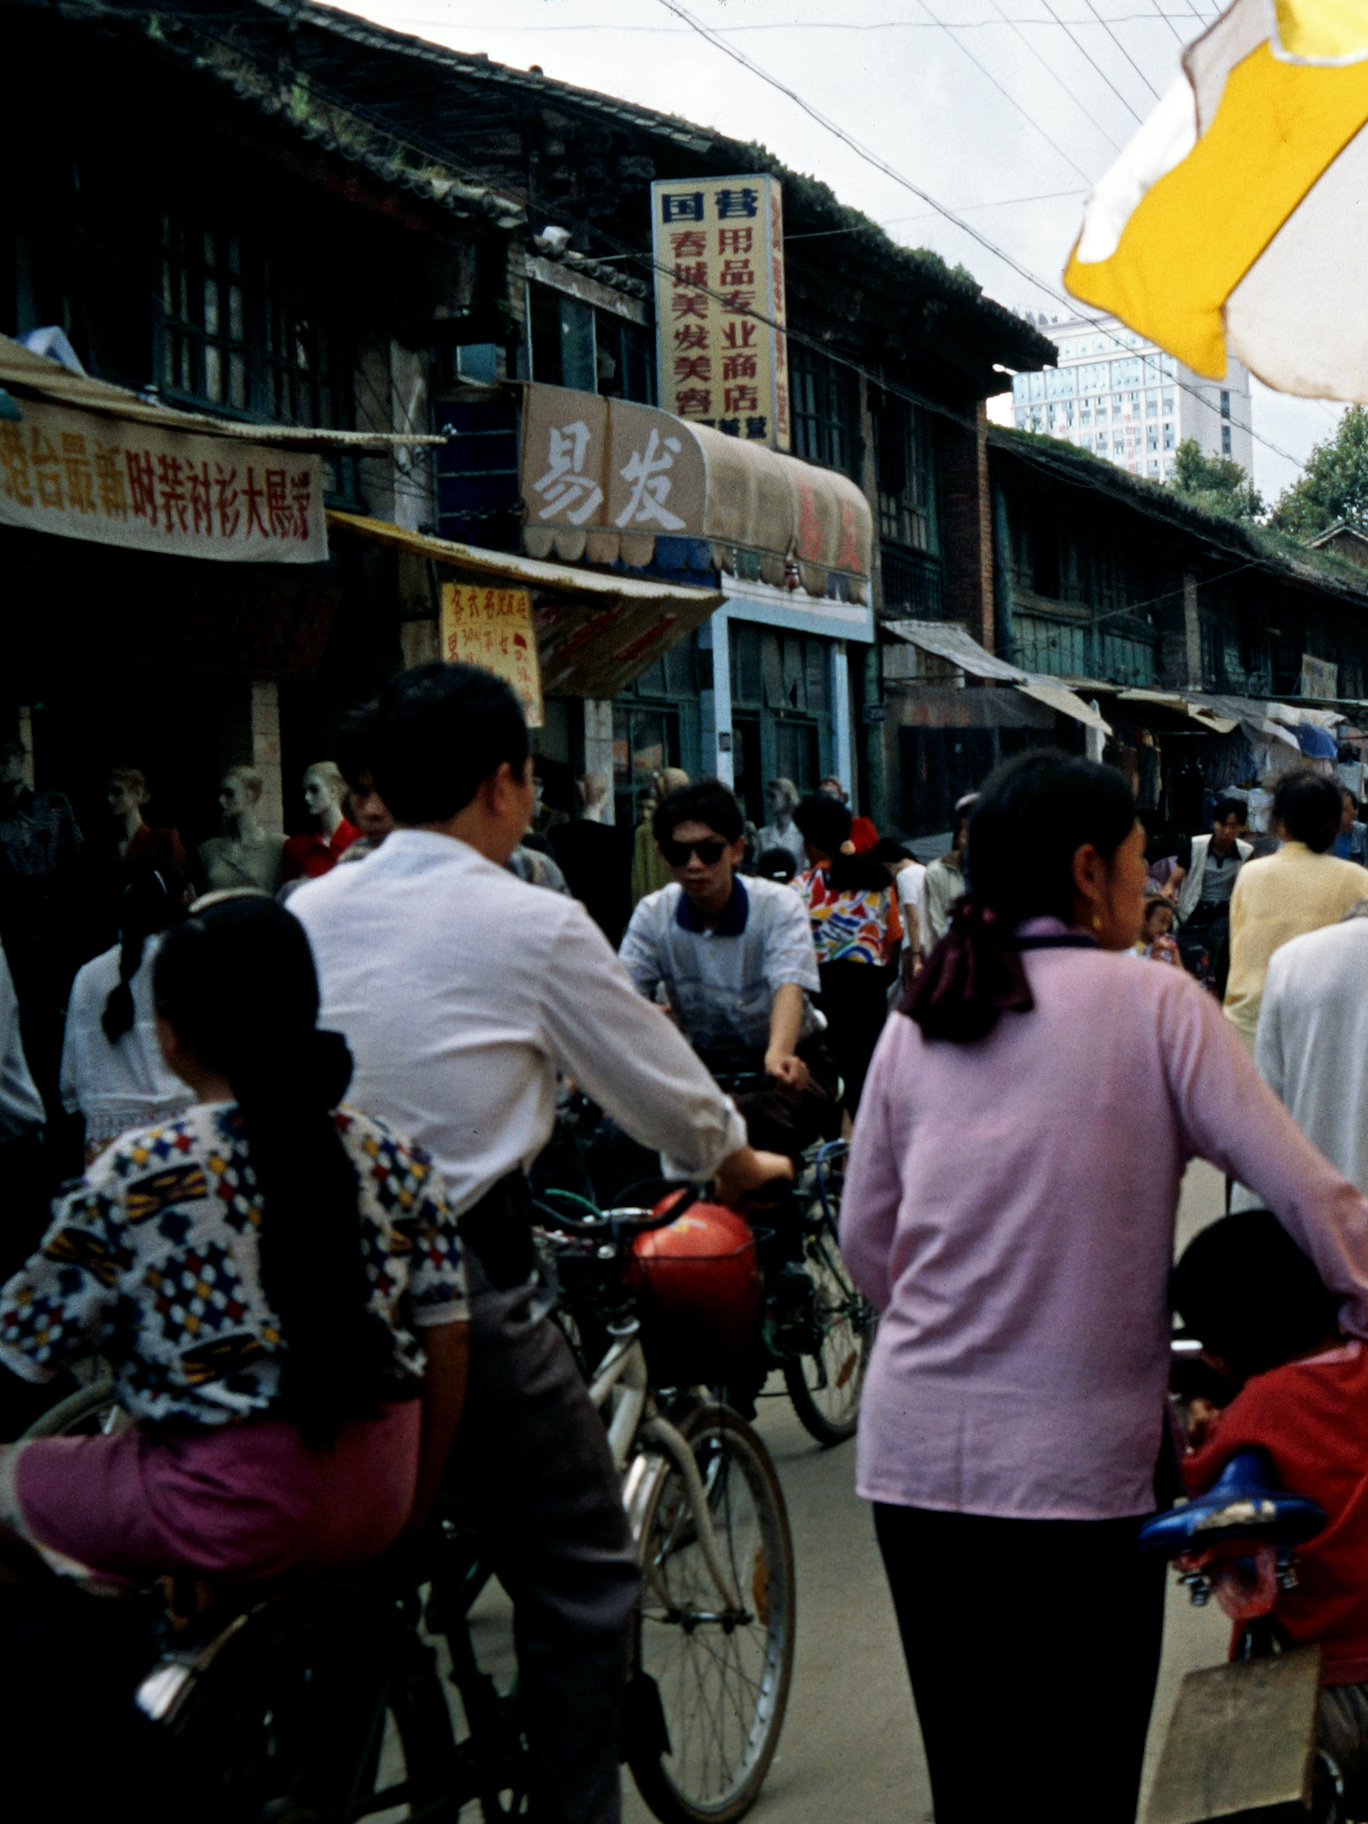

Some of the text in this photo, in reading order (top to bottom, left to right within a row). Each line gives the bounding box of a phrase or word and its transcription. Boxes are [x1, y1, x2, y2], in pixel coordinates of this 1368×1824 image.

[662, 188, 759, 225] 国营
[669, 230, 713, 416] 春城美发美容
[717, 226, 760, 414] 用品专业商店
[533, 418, 687, 531] 易发
